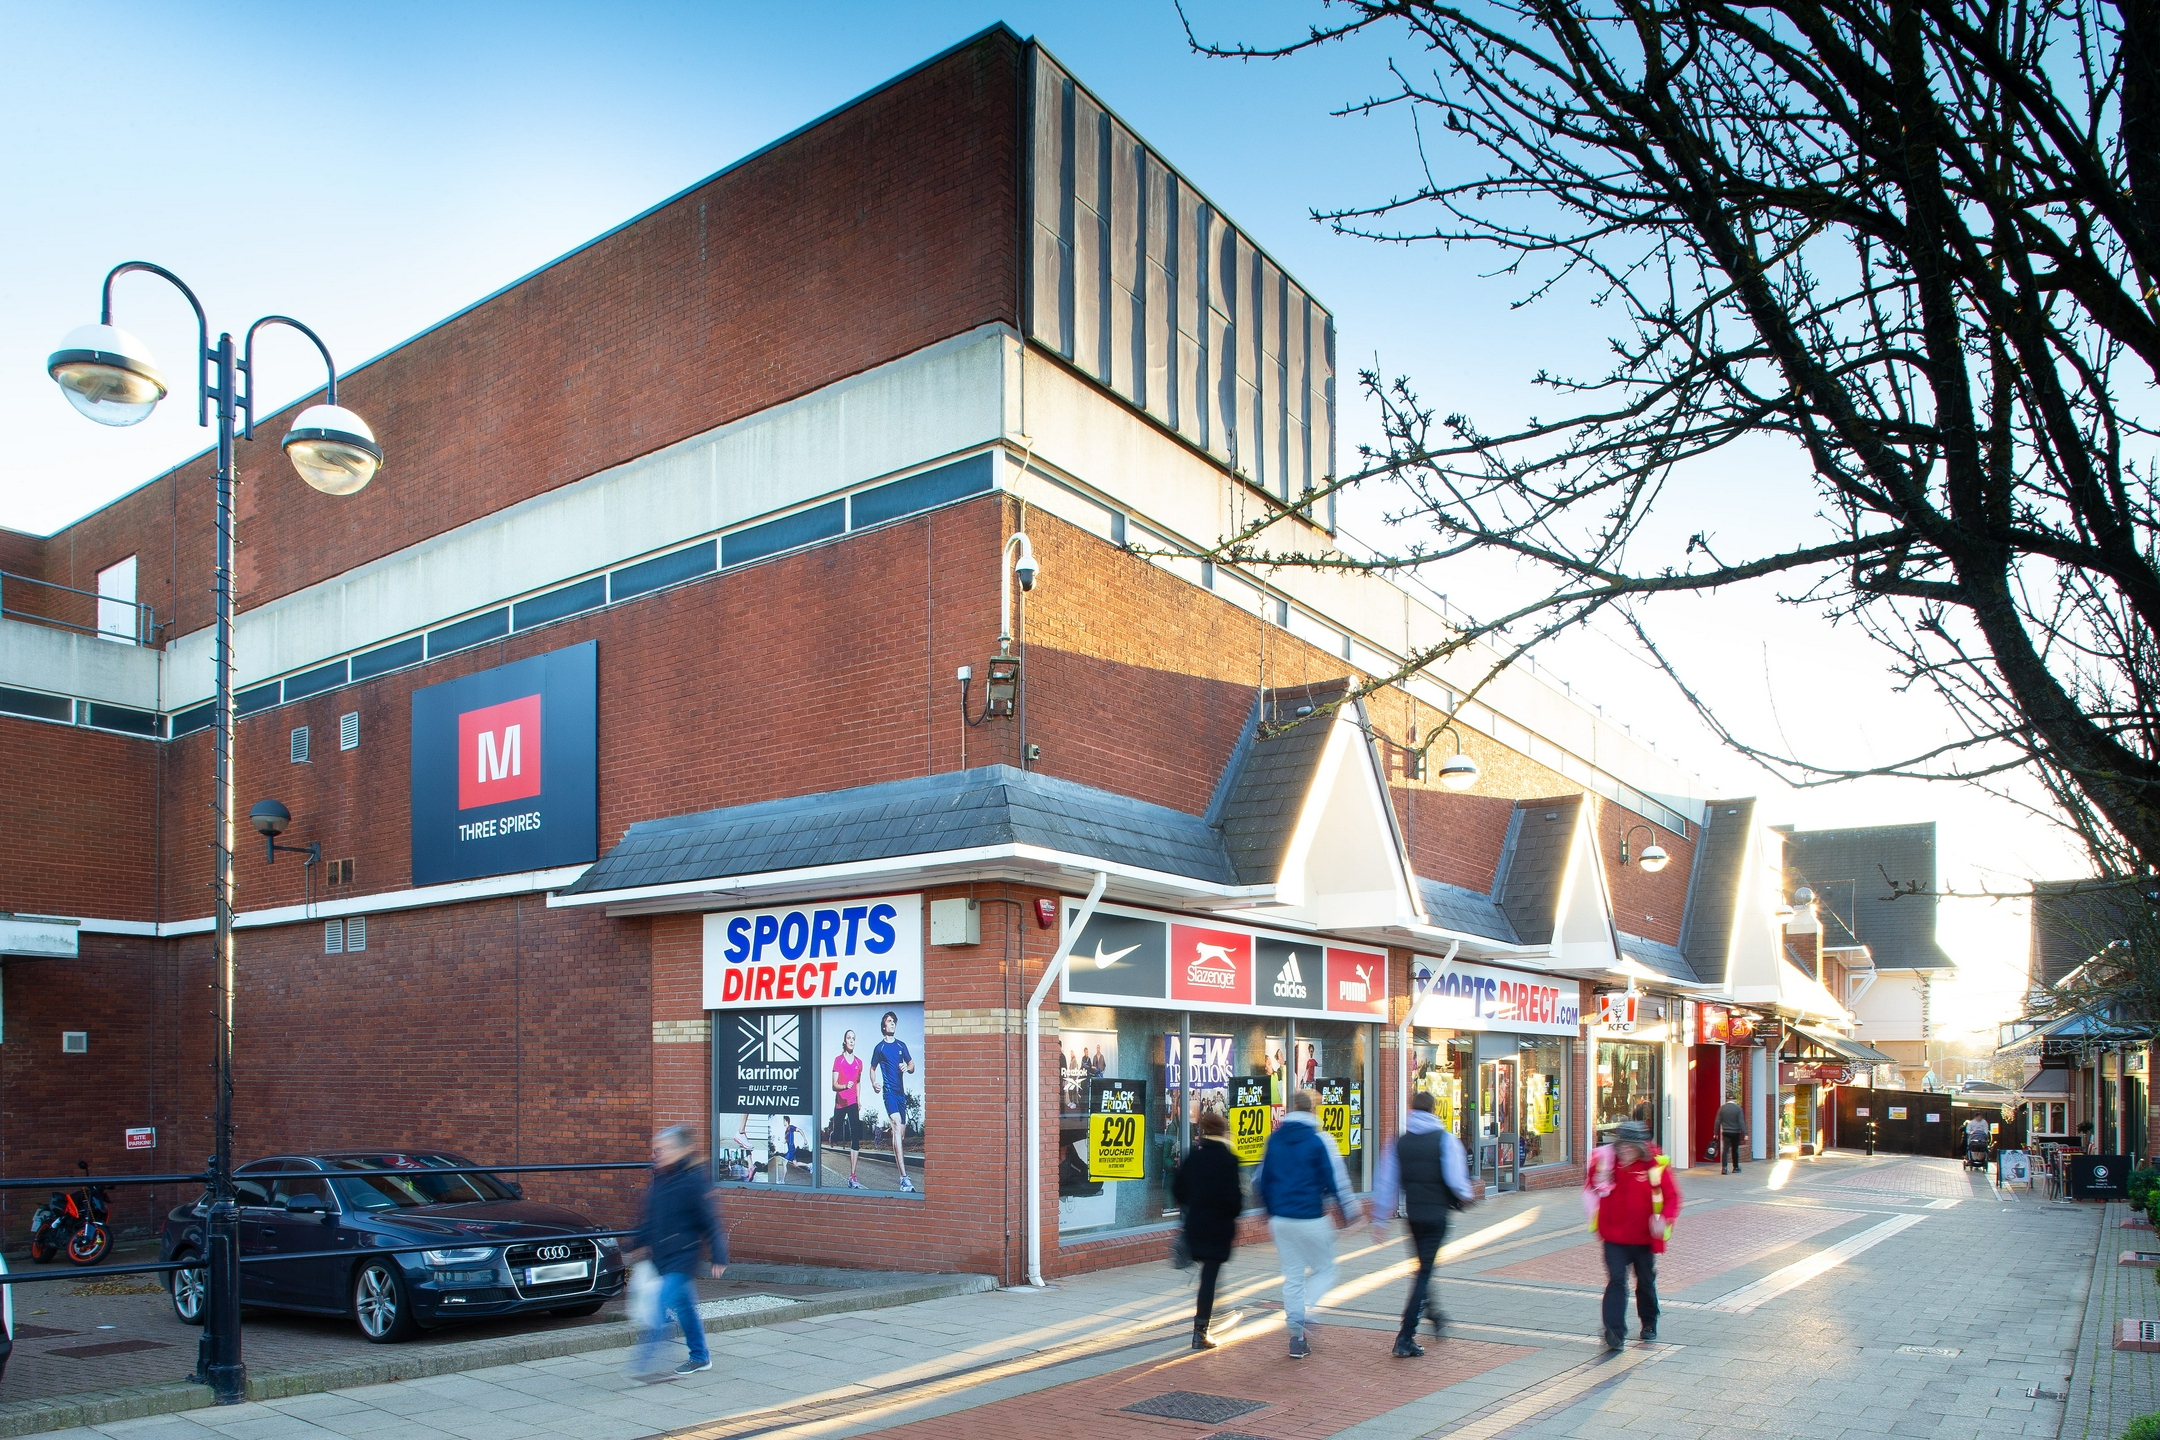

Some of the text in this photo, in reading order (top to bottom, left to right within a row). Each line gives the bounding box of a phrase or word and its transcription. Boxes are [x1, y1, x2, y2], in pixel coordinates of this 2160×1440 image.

[478, 723, 521, 783] M
[459, 811, 541, 842] THREE SPIRES
[724, 903, 898, 964] SPORTS
[721, 961, 898, 1002] DIRECT.COM
[1187, 965, 1236, 989] Slazenger
[1273, 981, 1307, 999] adidas
[1339, 980, 1367, 1003] PUMA
[1498, 980, 1578, 1026] DIRECT.COM
[1607, 1023, 1630, 1031] KFC
[737, 1064, 800, 1080] karrimor
[1060, 1067, 1088, 1077] Reebok
[1166, 1063, 1234, 1083] TRDITIONS
[1102, 1090, 1134, 1100] BLACK
[1237, 1094, 1262, 1104] FRIDAY
[1238, 1086, 1263, 1096] BLACK
[1322, 1087, 1344, 1095] BLACK
[1322, 1094, 1343, 1102] FRIDAY
[737, 1095, 800, 1107] RUNNING
[1101, 1100, 1134, 1110] FRIDAY
[1238, 1108, 1264, 1136] £20
[1322, 1107, 1344, 1131] £20
[1101, 1117, 1136, 1147] £20
[1237, 1135, 1264, 1144] VOUCHER
